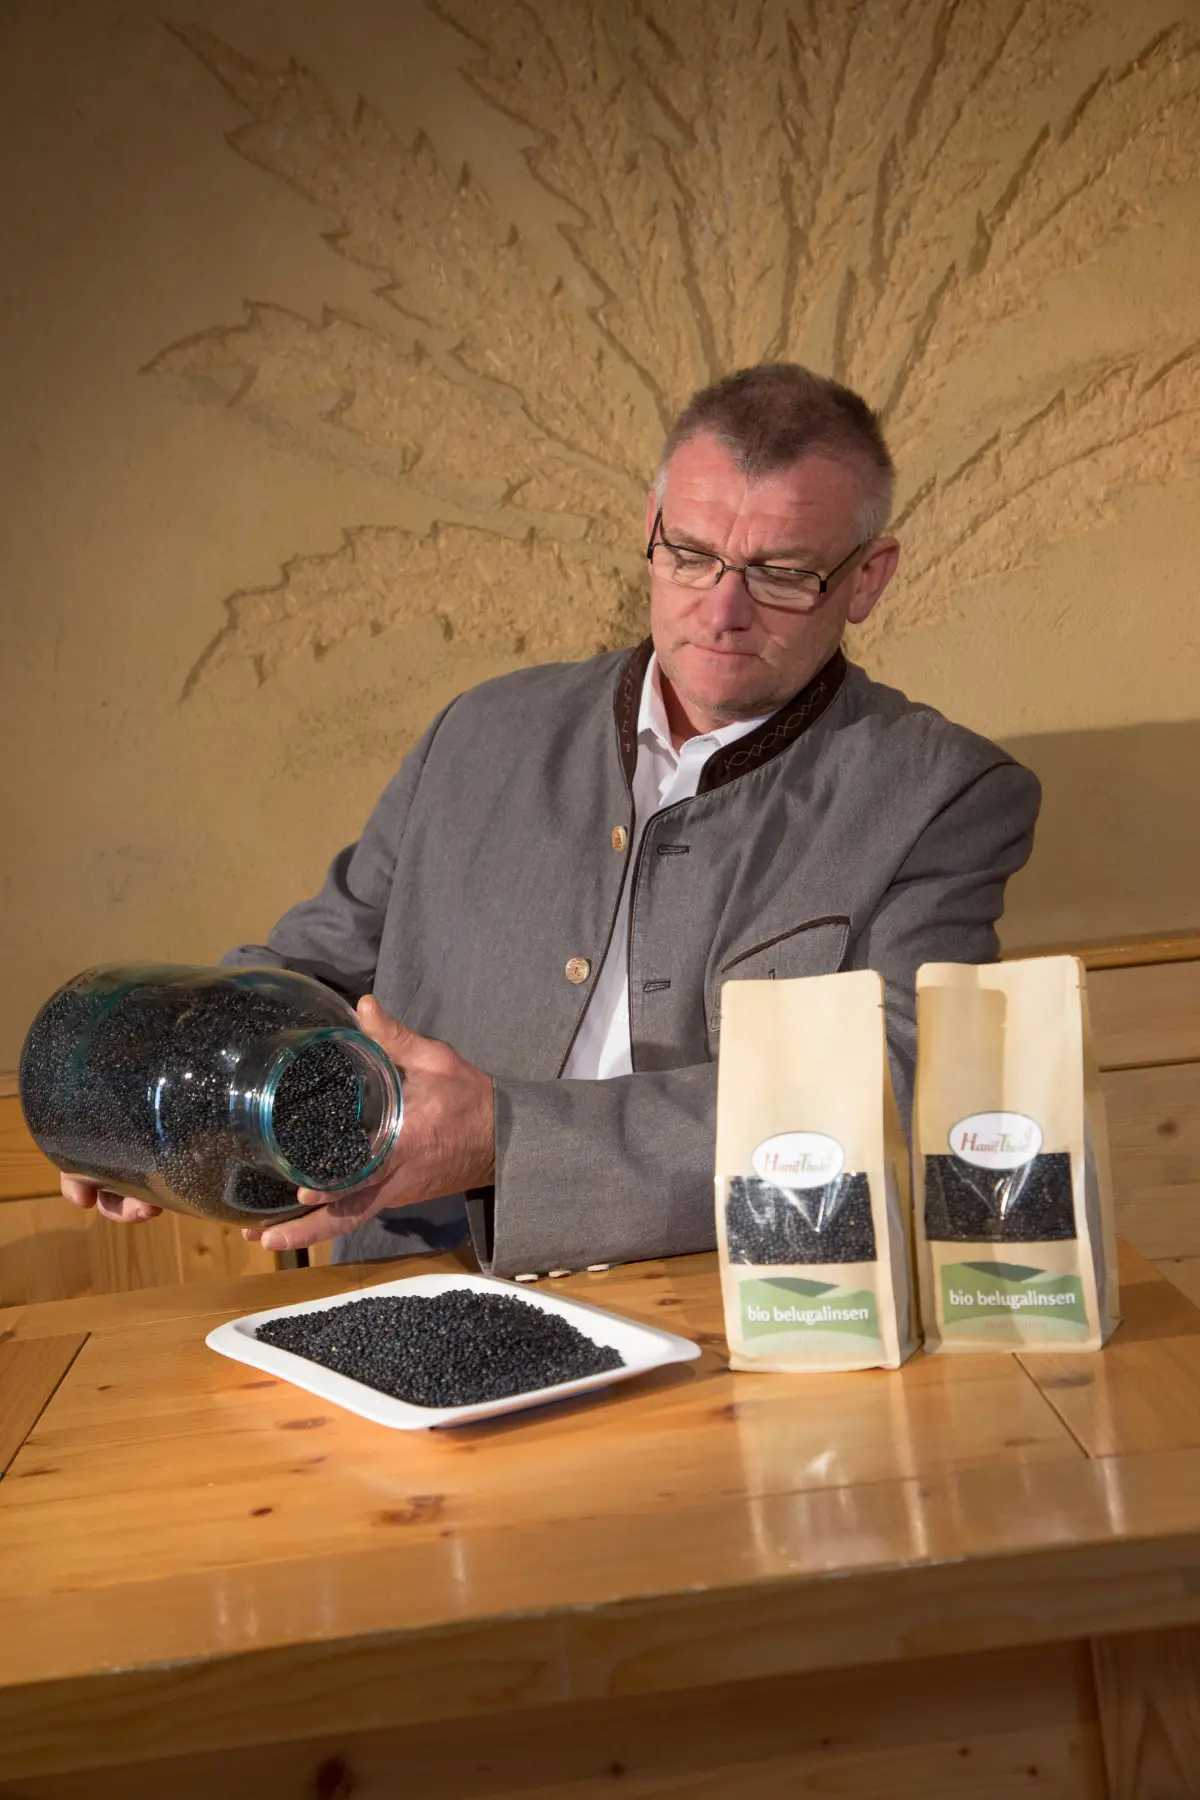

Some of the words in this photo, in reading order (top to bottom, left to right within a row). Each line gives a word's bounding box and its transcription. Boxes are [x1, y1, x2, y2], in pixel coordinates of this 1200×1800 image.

[950, 1290, 974, 1306] bio
[977, 1290, 1076, 1310] belugalinsen
[747, 1306, 770, 1322] bio
[773, 1305, 869, 1325] belugalinsen
